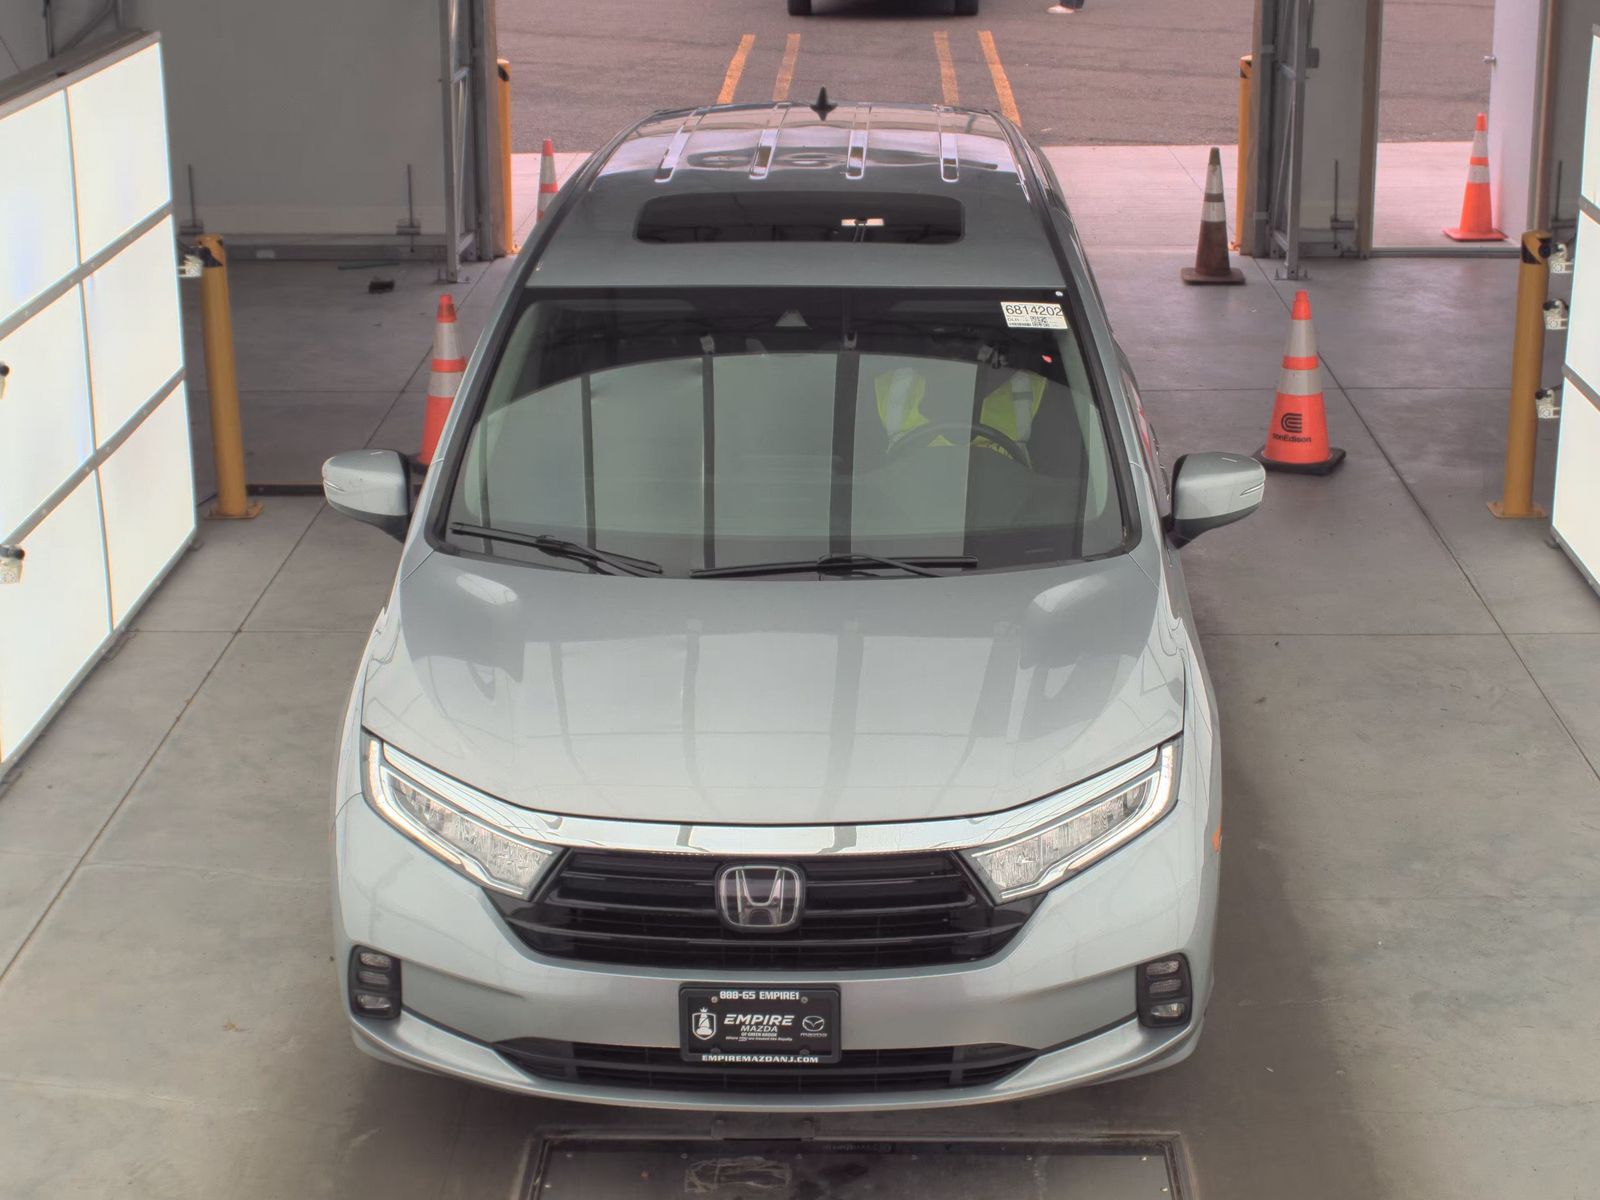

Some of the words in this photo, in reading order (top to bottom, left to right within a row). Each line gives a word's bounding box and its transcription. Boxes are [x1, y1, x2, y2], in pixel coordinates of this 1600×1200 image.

[1005, 305, 1064, 316] 6814202
[719, 990, 756, 1000] 888-65
[759, 991, 800, 1001] EMPIRE1
[724, 1014, 794, 1025] EMPIRE
[740, 1025, 778, 1033] MAZDA
[702, 1054, 818, 1063] EMPIREMAZDANJ.COM
